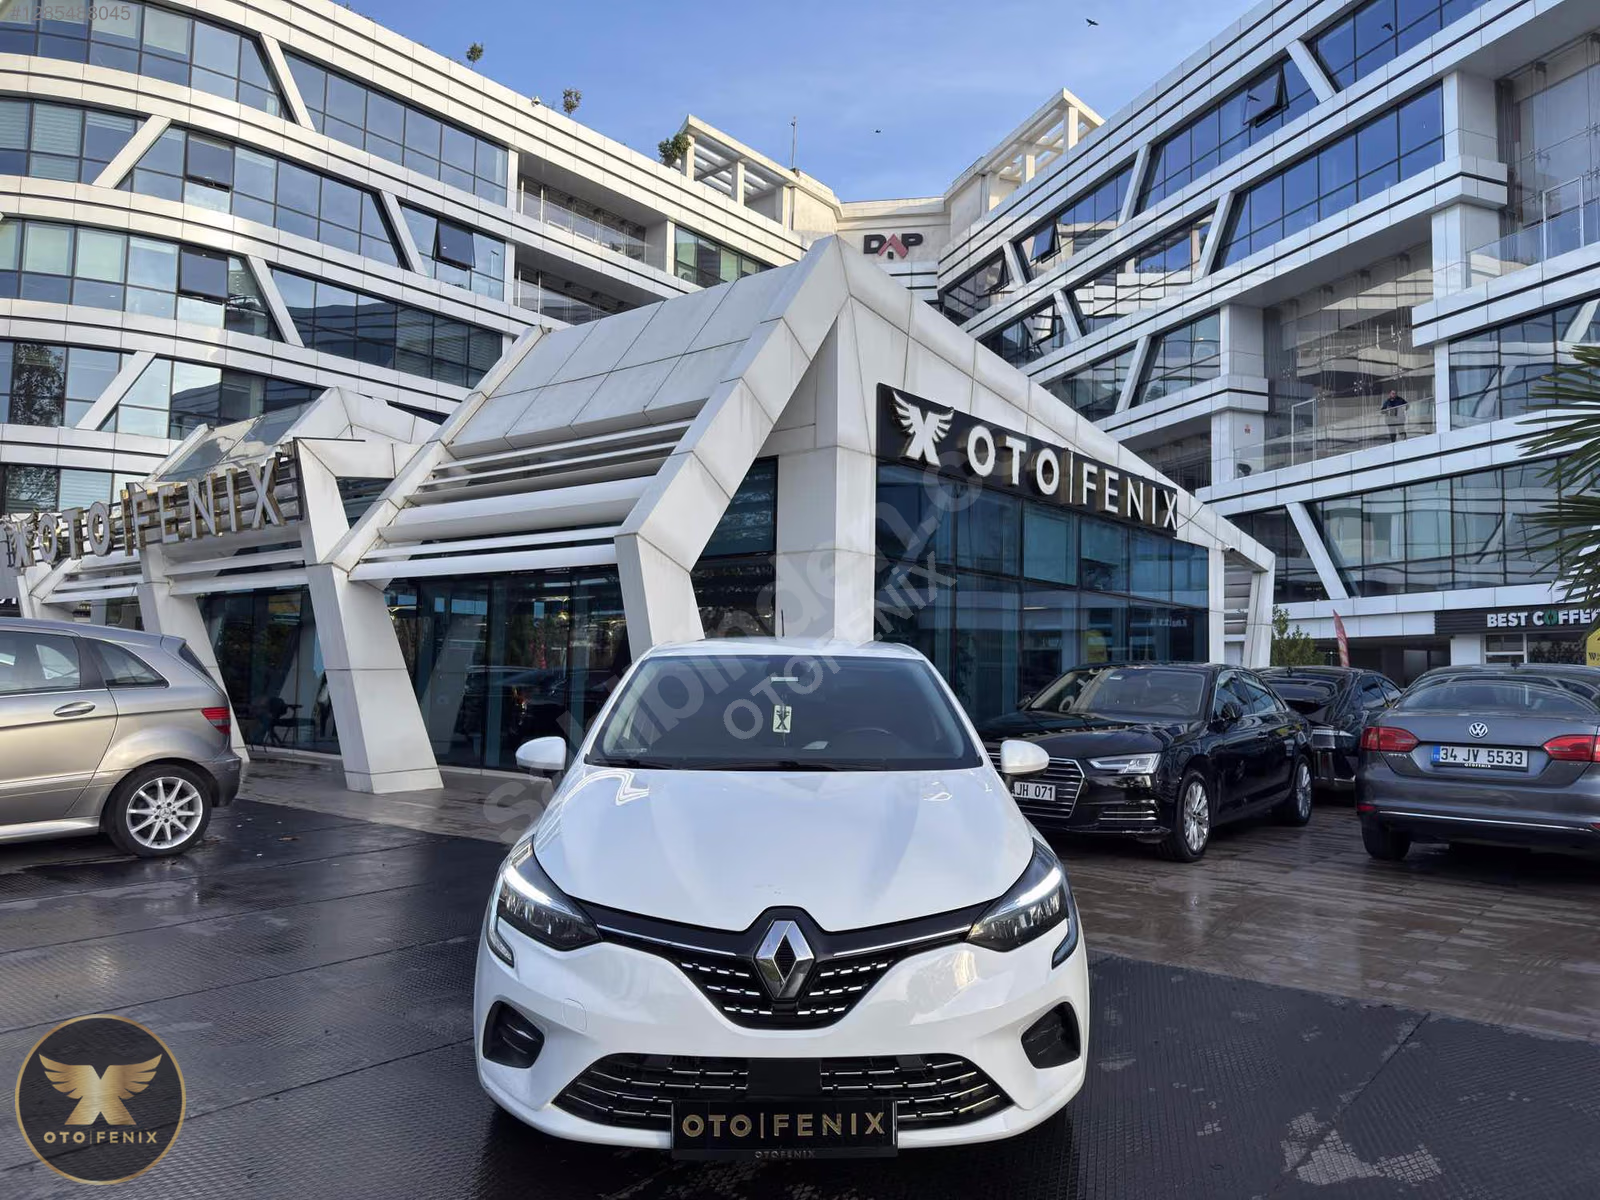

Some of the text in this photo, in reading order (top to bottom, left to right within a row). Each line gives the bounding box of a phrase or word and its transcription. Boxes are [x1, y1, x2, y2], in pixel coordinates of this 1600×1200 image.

[863, 233, 924, 260] DAP
[1486, 611, 1528, 628] BEST
[1440, 747, 1524, 766] 34 JV 5533
[1034, 785, 1054, 800] 071
